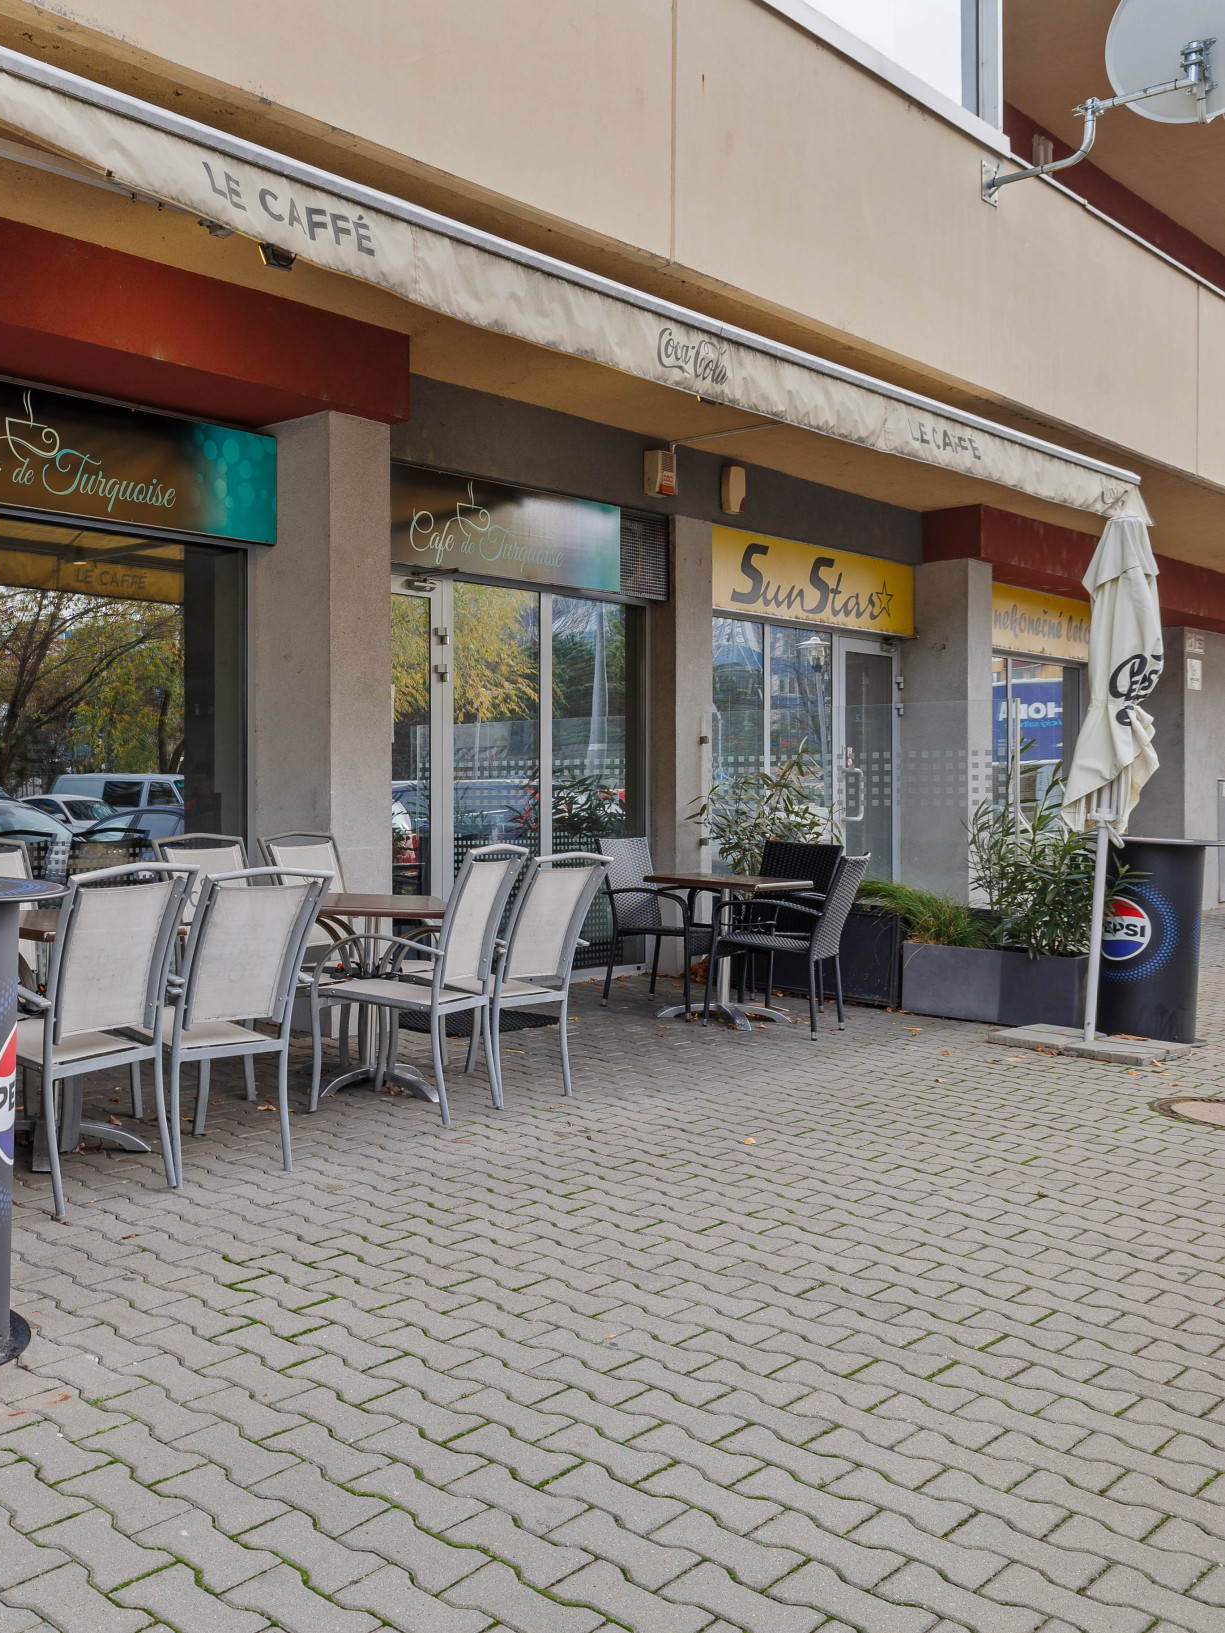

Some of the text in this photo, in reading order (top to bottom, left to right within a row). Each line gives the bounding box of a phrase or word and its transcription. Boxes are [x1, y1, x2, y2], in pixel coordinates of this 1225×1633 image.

[202, 161, 376, 257] LE CAFFÉ
[657, 327, 729, 386] Coca-Cola
[907, 417, 931, 446] LE
[12, 458, 35, 486] de
[42, 449, 177, 513] Turquoise
[410, 507, 564, 574] Cafe de Turquoise
[74, 567, 148, 590] LE CAFFÉ
[993, 603, 1064, 640] nekonečné
[1103, 920, 1147, 938] EPSI
